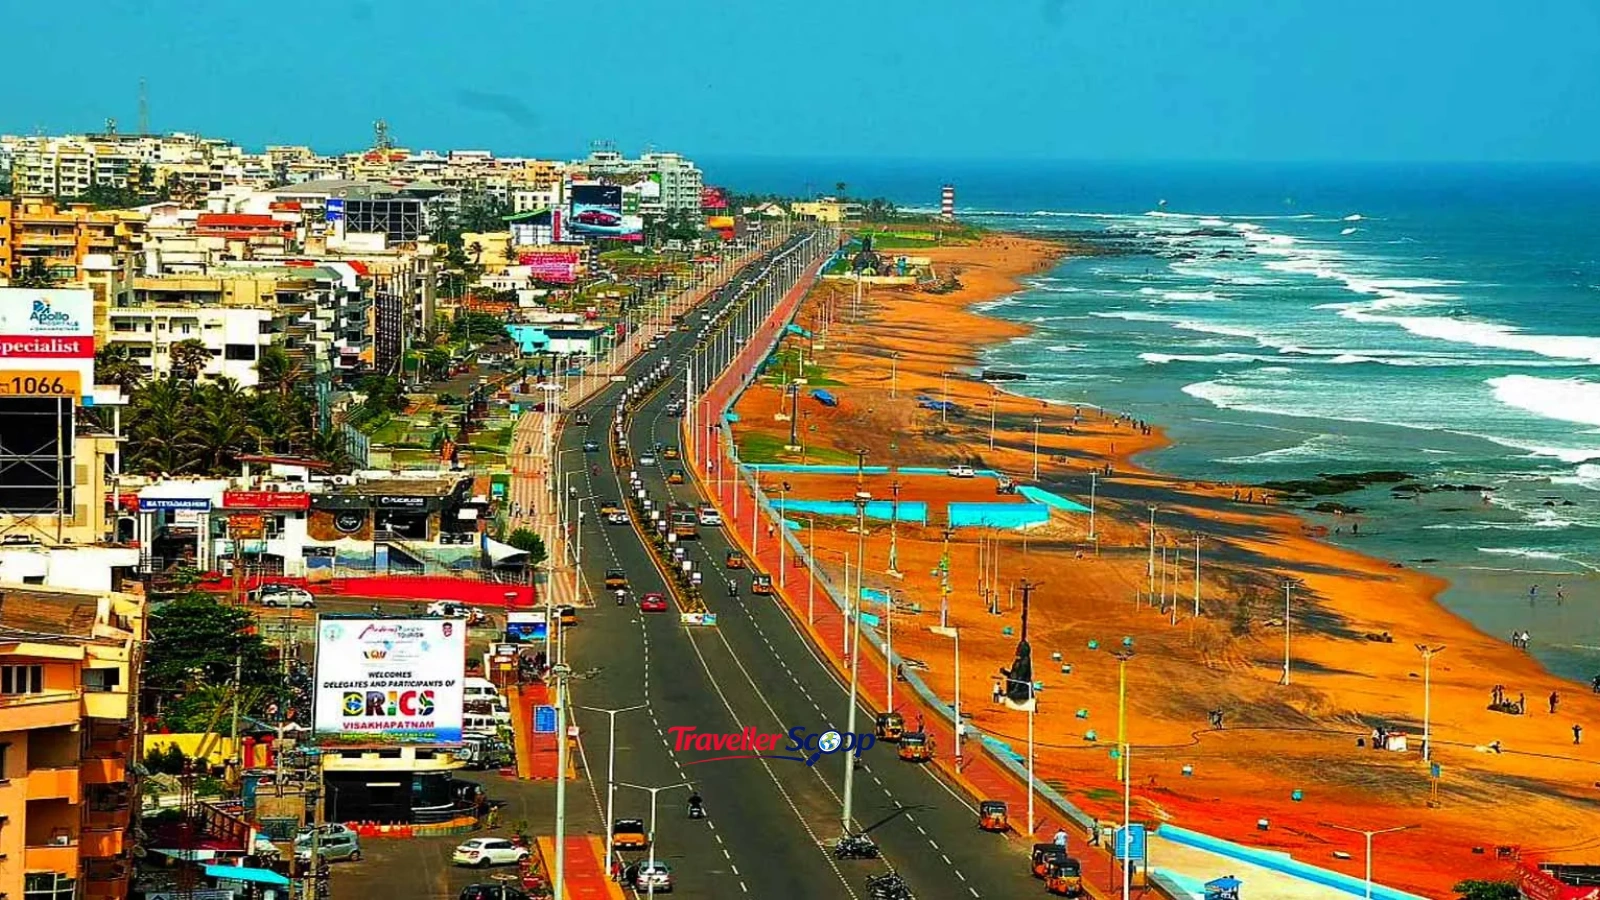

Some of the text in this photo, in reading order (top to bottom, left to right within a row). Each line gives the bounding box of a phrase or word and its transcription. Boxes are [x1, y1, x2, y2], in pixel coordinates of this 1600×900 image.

[30, 312, 70, 325] Apollo
[0, 338, 80, 355] pecialist
[11, 376, 64, 394] 1066
[368, 671, 412, 679] WELCOMES
[323, 681, 368, 689] DELEGATES
[343, 690, 435, 716] BRICS
[343, 721, 435, 730] VISAKHAPATNAM
